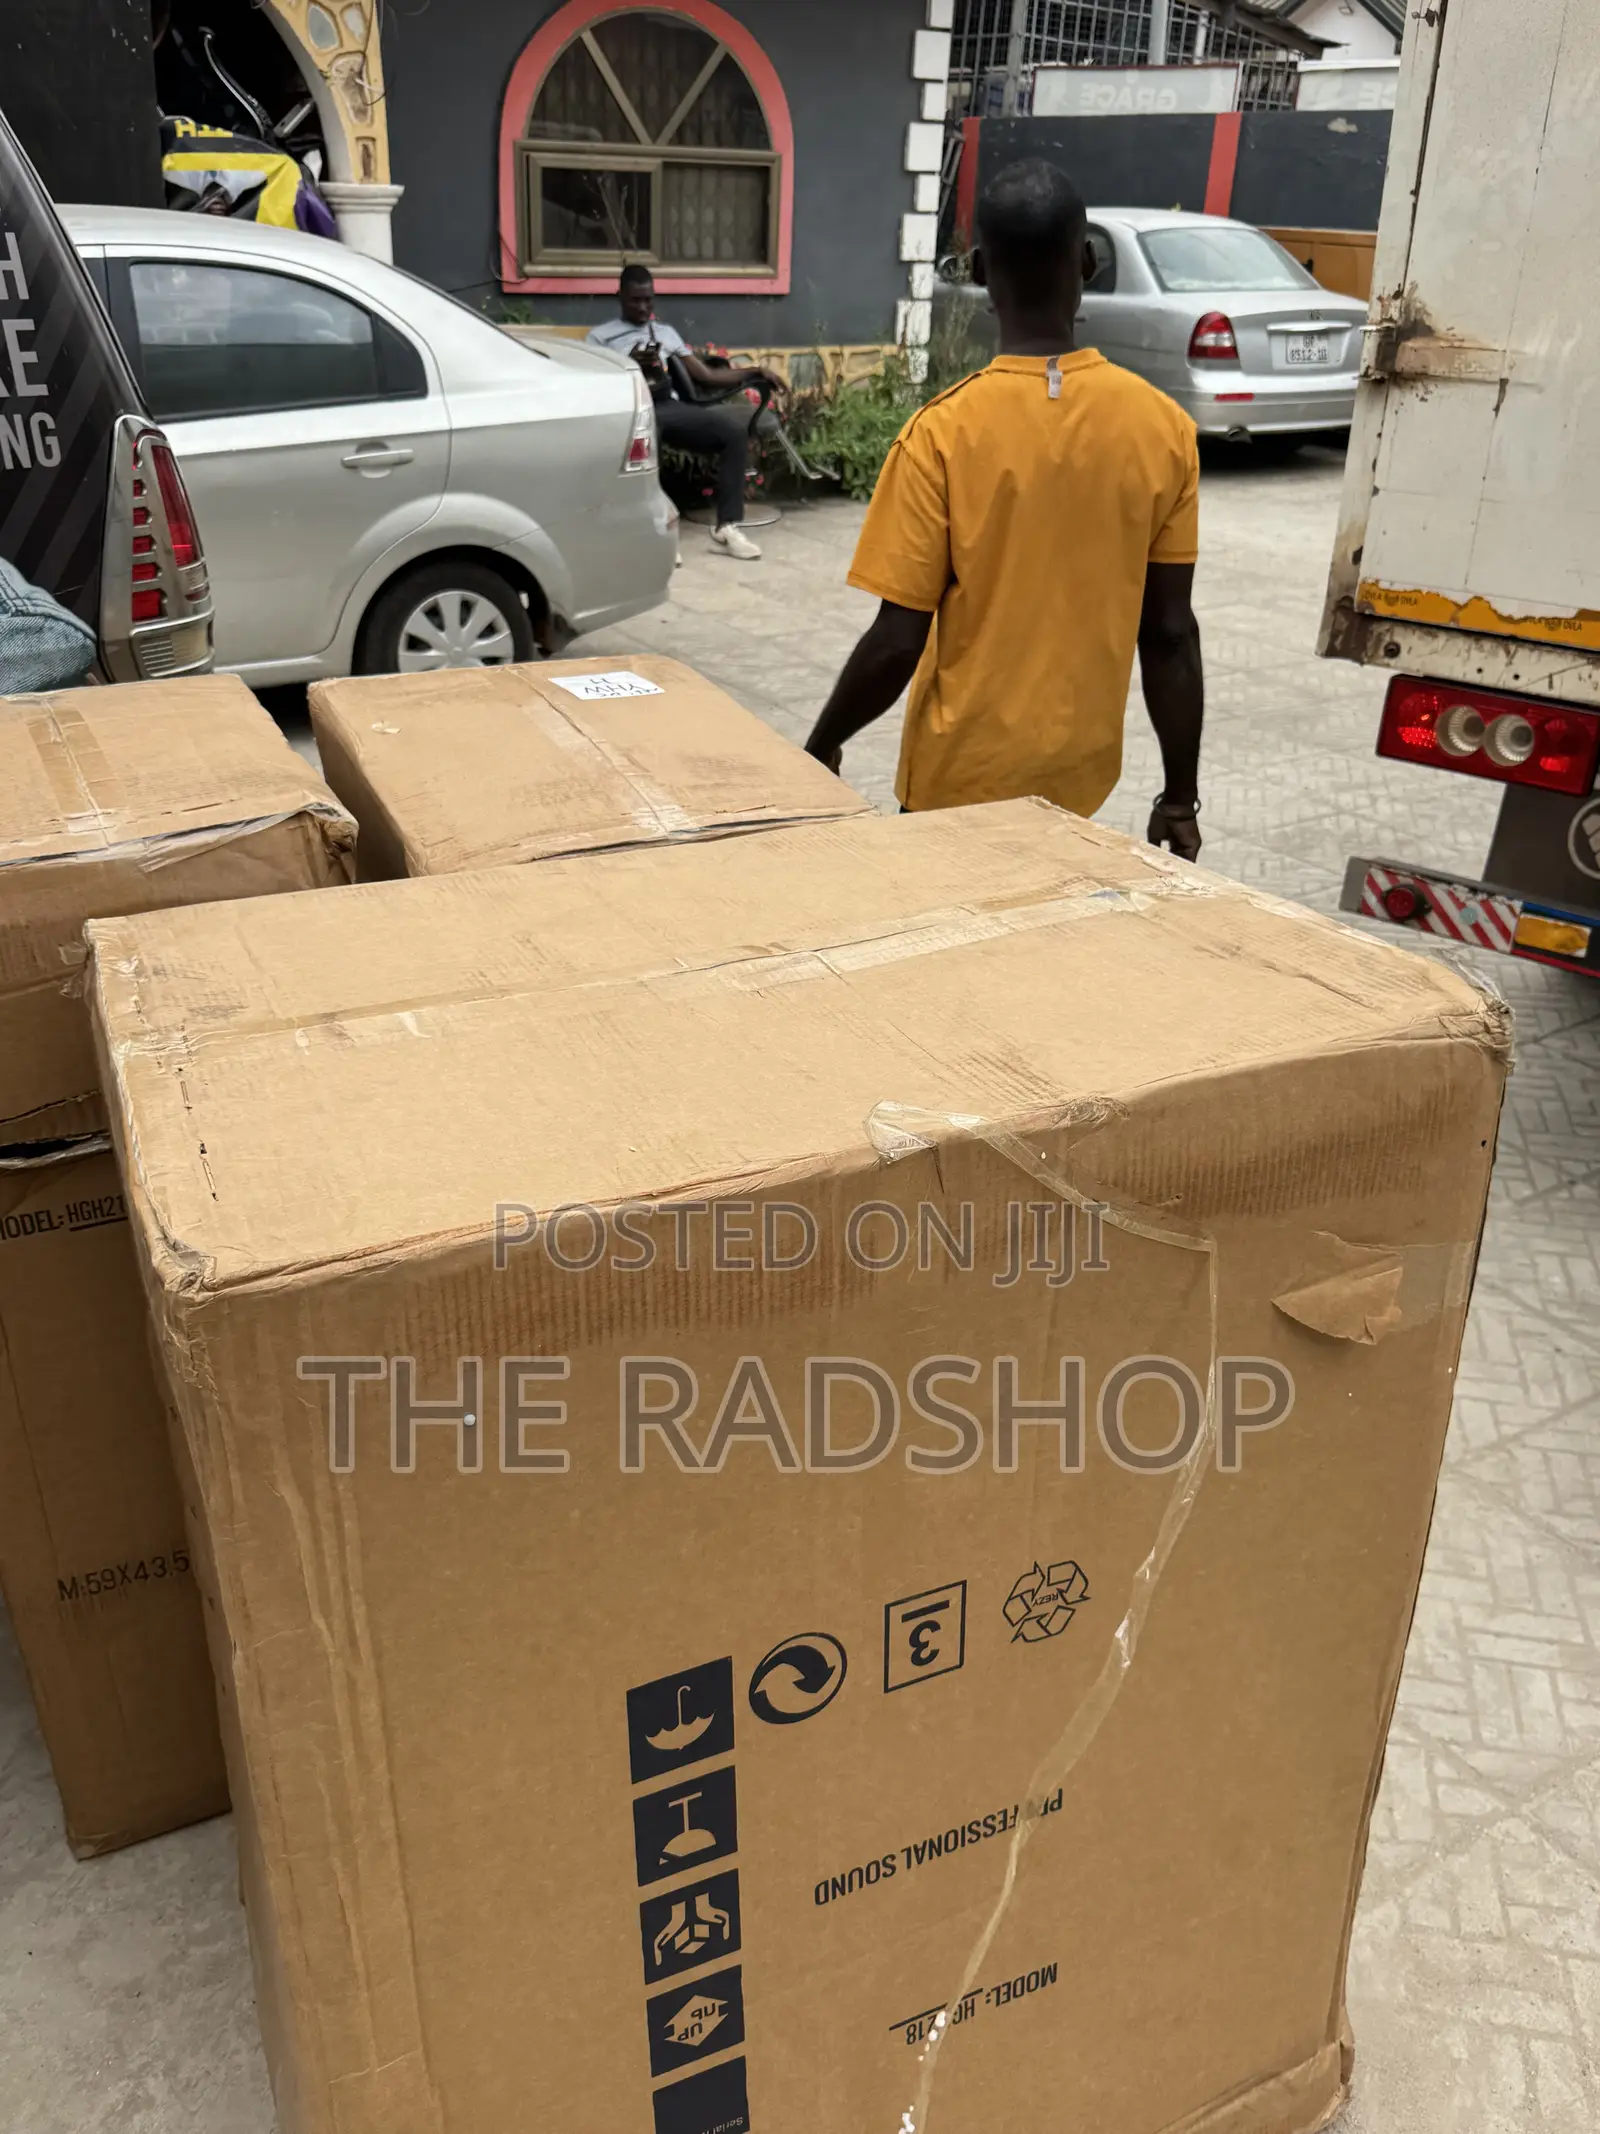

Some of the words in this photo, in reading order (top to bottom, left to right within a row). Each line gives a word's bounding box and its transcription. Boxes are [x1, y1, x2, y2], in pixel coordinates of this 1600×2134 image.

[1031, 1593, 1059, 1608] REZY
[900, 1788, 1064, 1870] PFESSIONAL
[813, 1853, 897, 1906] SOUND
[984, 1962, 1058, 2008] MODEL:
[905, 1997, 976, 2046] HG218
